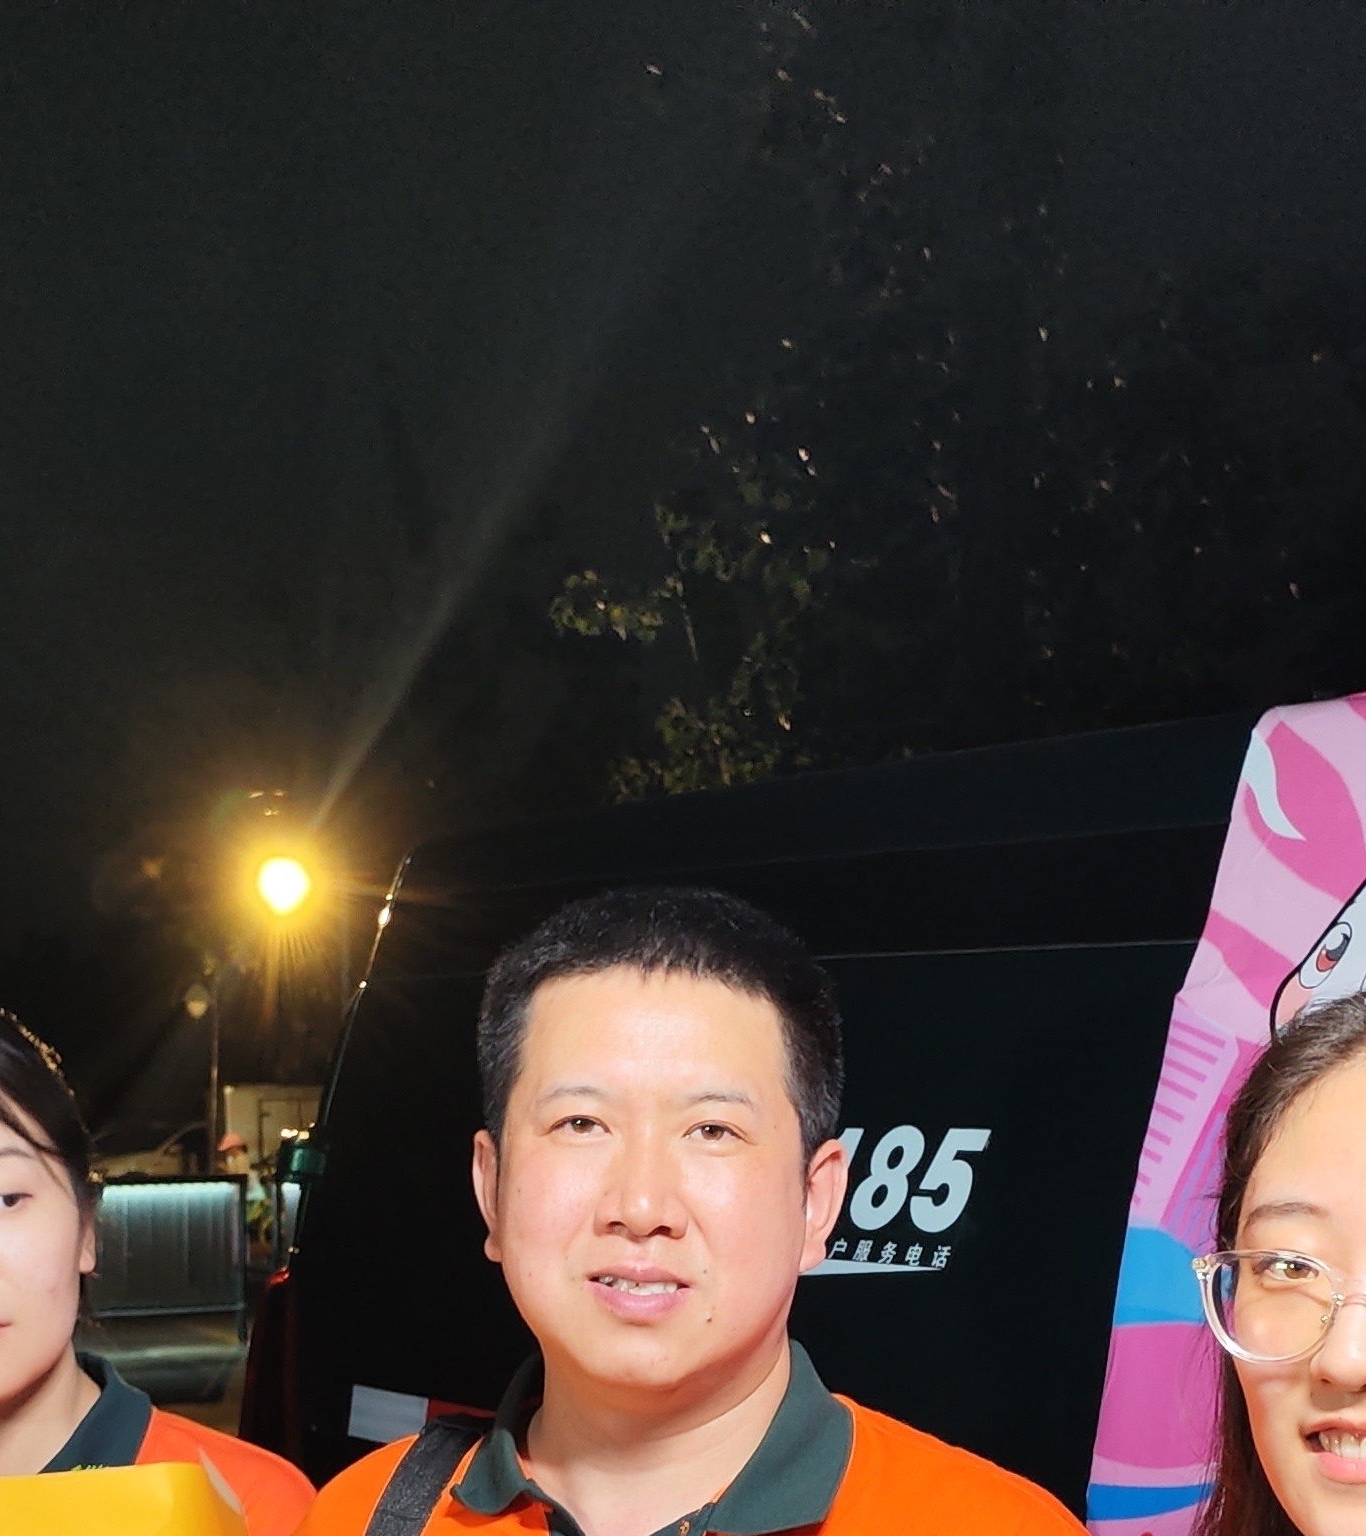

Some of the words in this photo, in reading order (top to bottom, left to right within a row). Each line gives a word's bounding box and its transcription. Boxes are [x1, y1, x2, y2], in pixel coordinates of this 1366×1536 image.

[828, 1238, 952, 1270] 户服务电话
